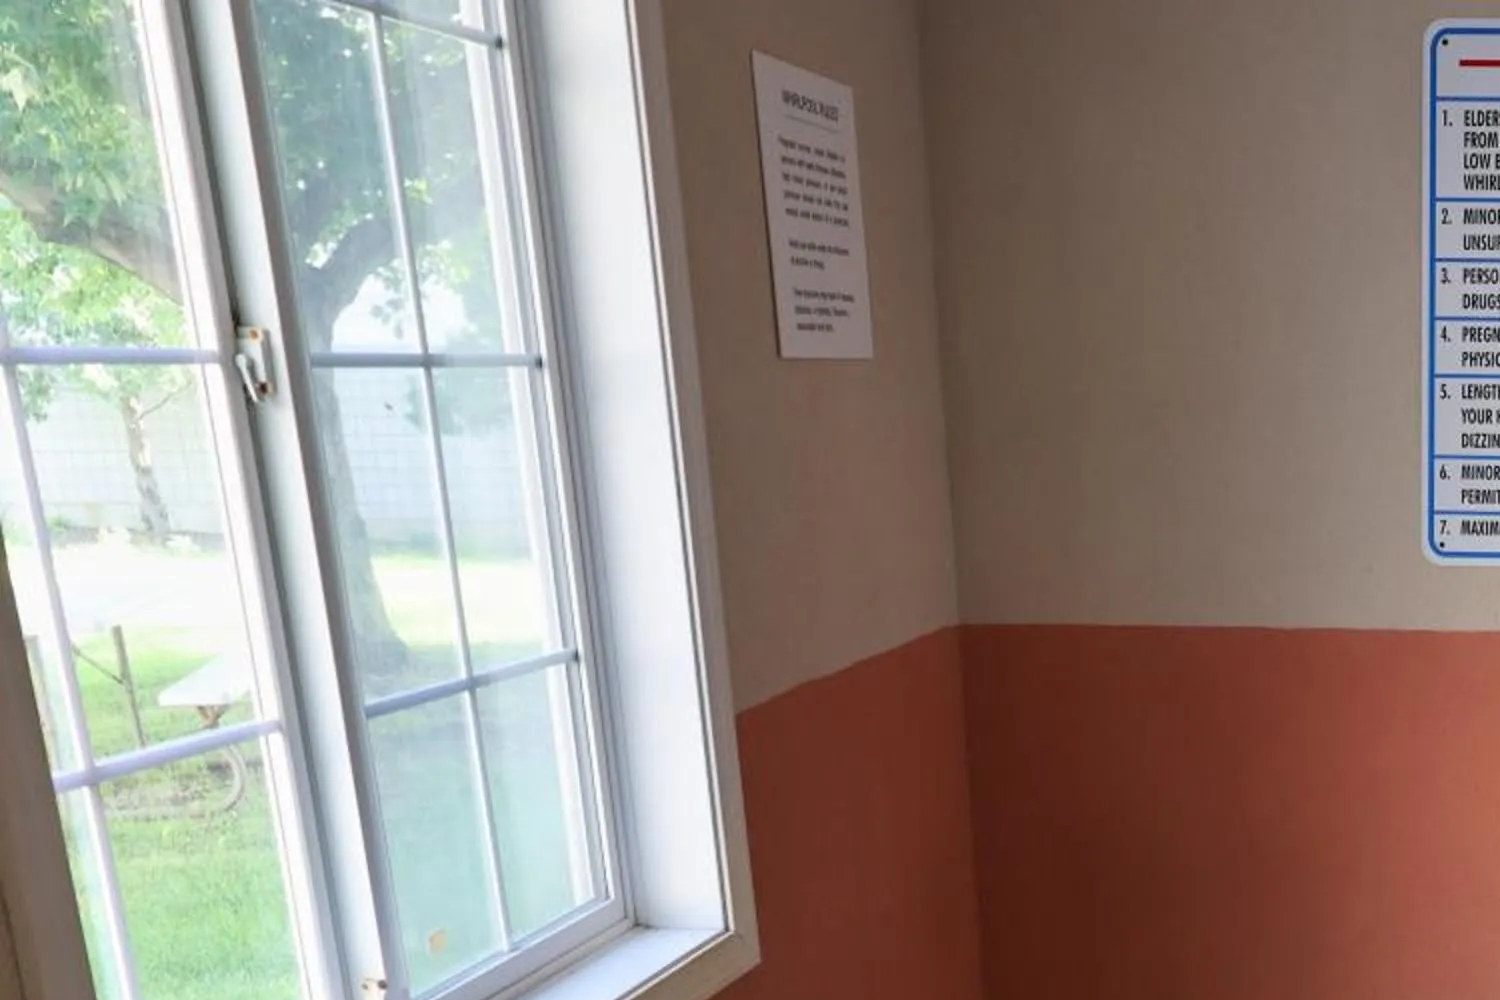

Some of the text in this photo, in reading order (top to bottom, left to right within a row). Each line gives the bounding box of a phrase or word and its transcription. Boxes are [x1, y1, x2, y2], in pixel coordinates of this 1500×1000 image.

[1442, 110, 1452, 127] 1.
[1463, 132, 1499, 149] FROM
[1463, 154, 1492, 170] LOW
[1441, 209, 1452, 225] 2.
[1441, 269, 1451, 285] 3.
[1440, 327, 1451, 343] 4.
[1440, 385, 1450, 400] 5.
[1461, 409, 1493, 425] YOUR
[1439, 465, 1450, 480] 6.
[1440, 521, 1450, 536] 7.
